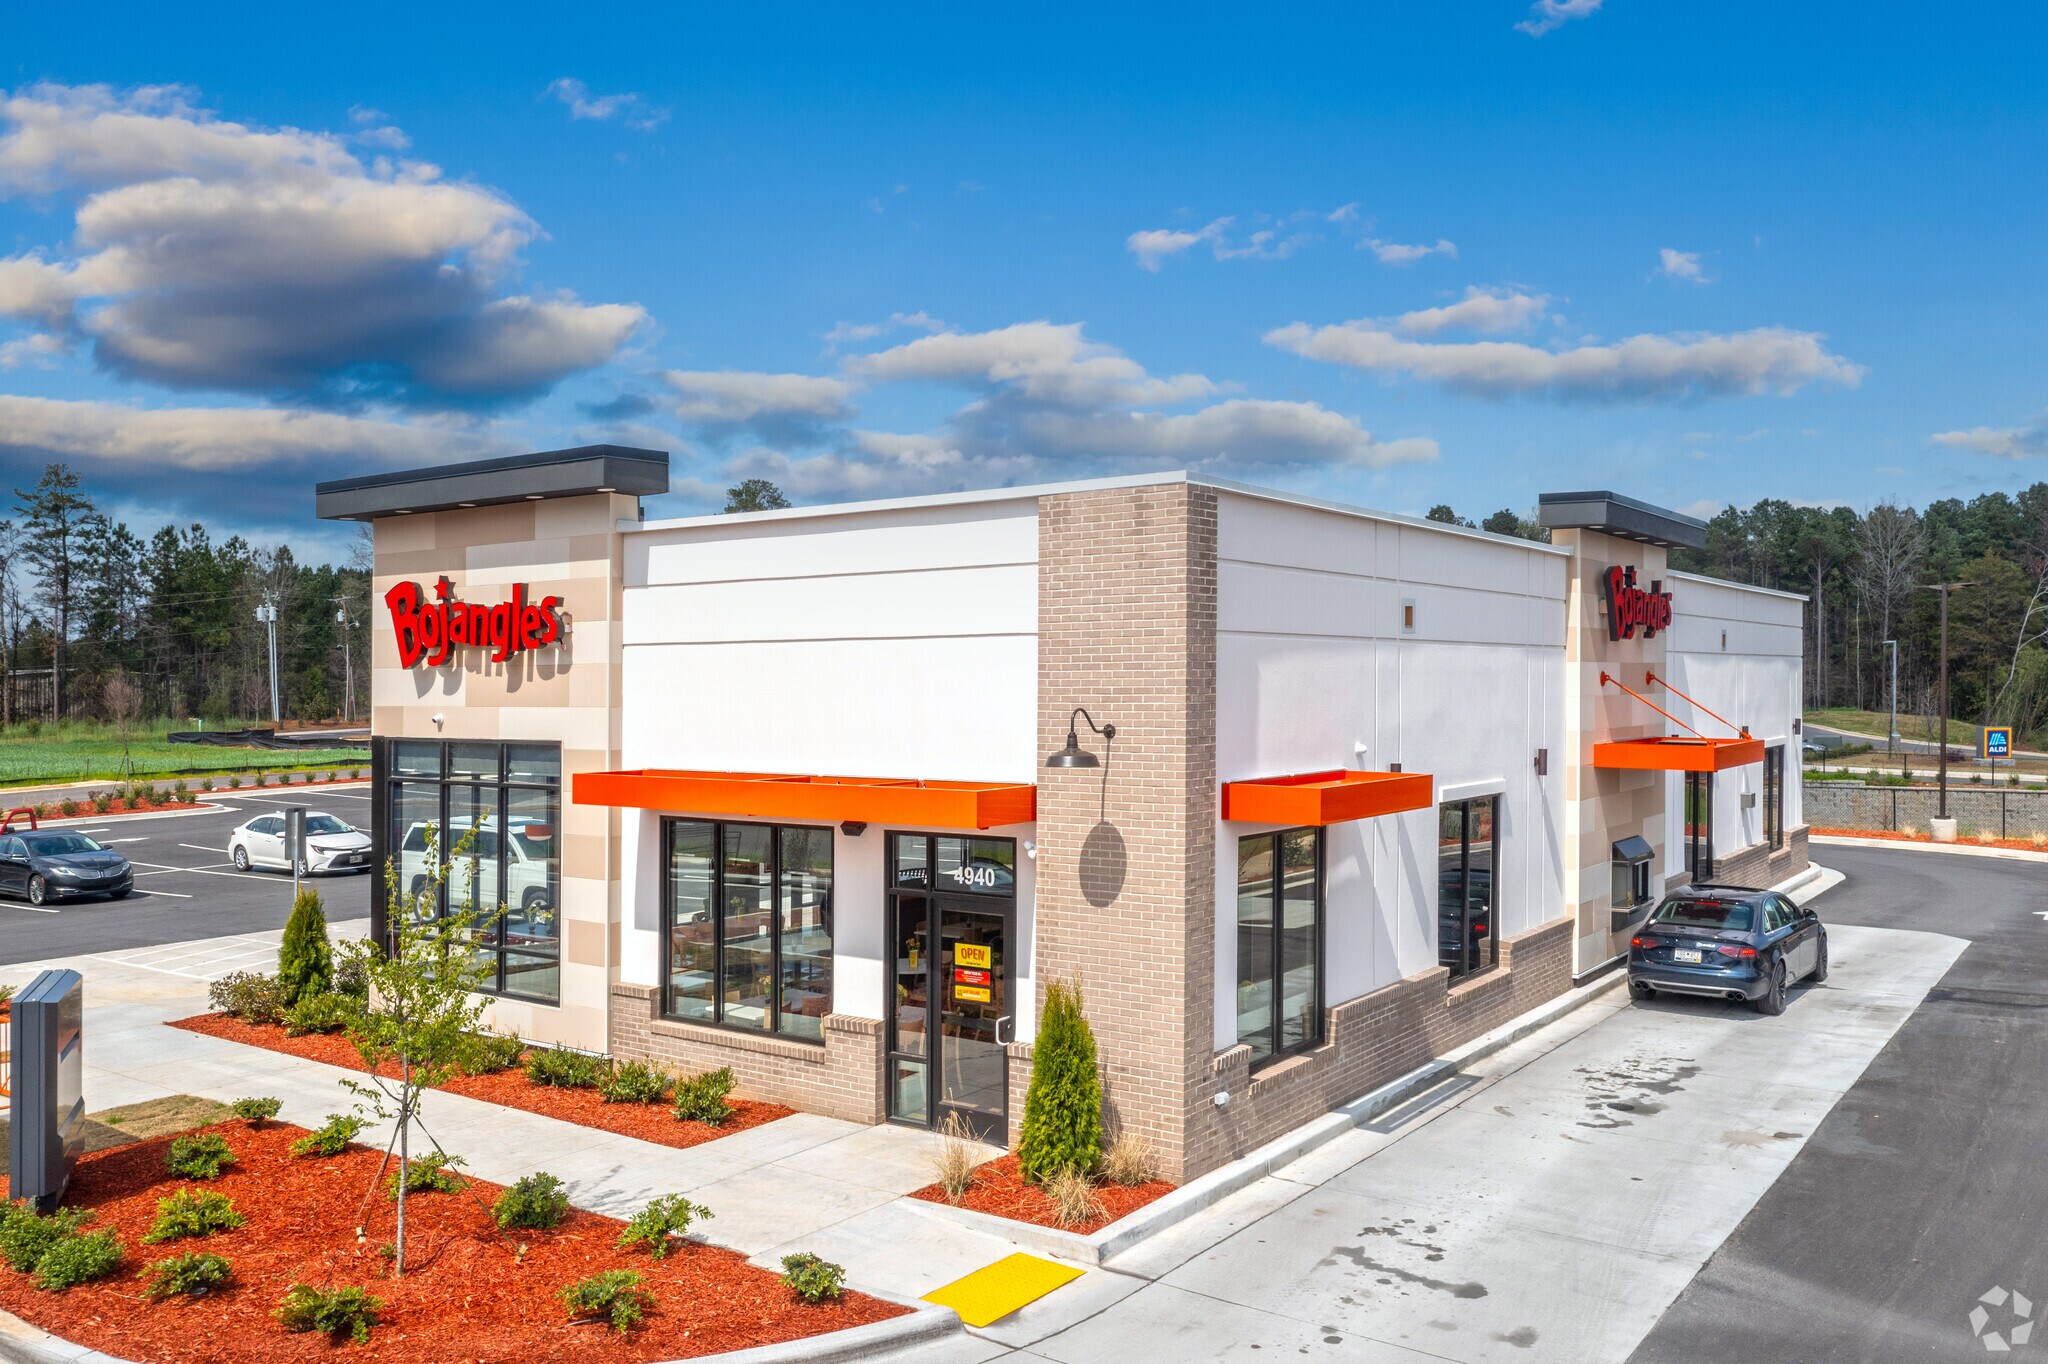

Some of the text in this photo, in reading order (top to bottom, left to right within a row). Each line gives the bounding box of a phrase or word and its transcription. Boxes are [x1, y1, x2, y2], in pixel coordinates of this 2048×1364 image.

[385, 576, 564, 669] Bojangles
[1603, 565, 1673, 641] Bojangles
[954, 867, 995, 887] 4940
[961, 947, 985, 962] OPEN
